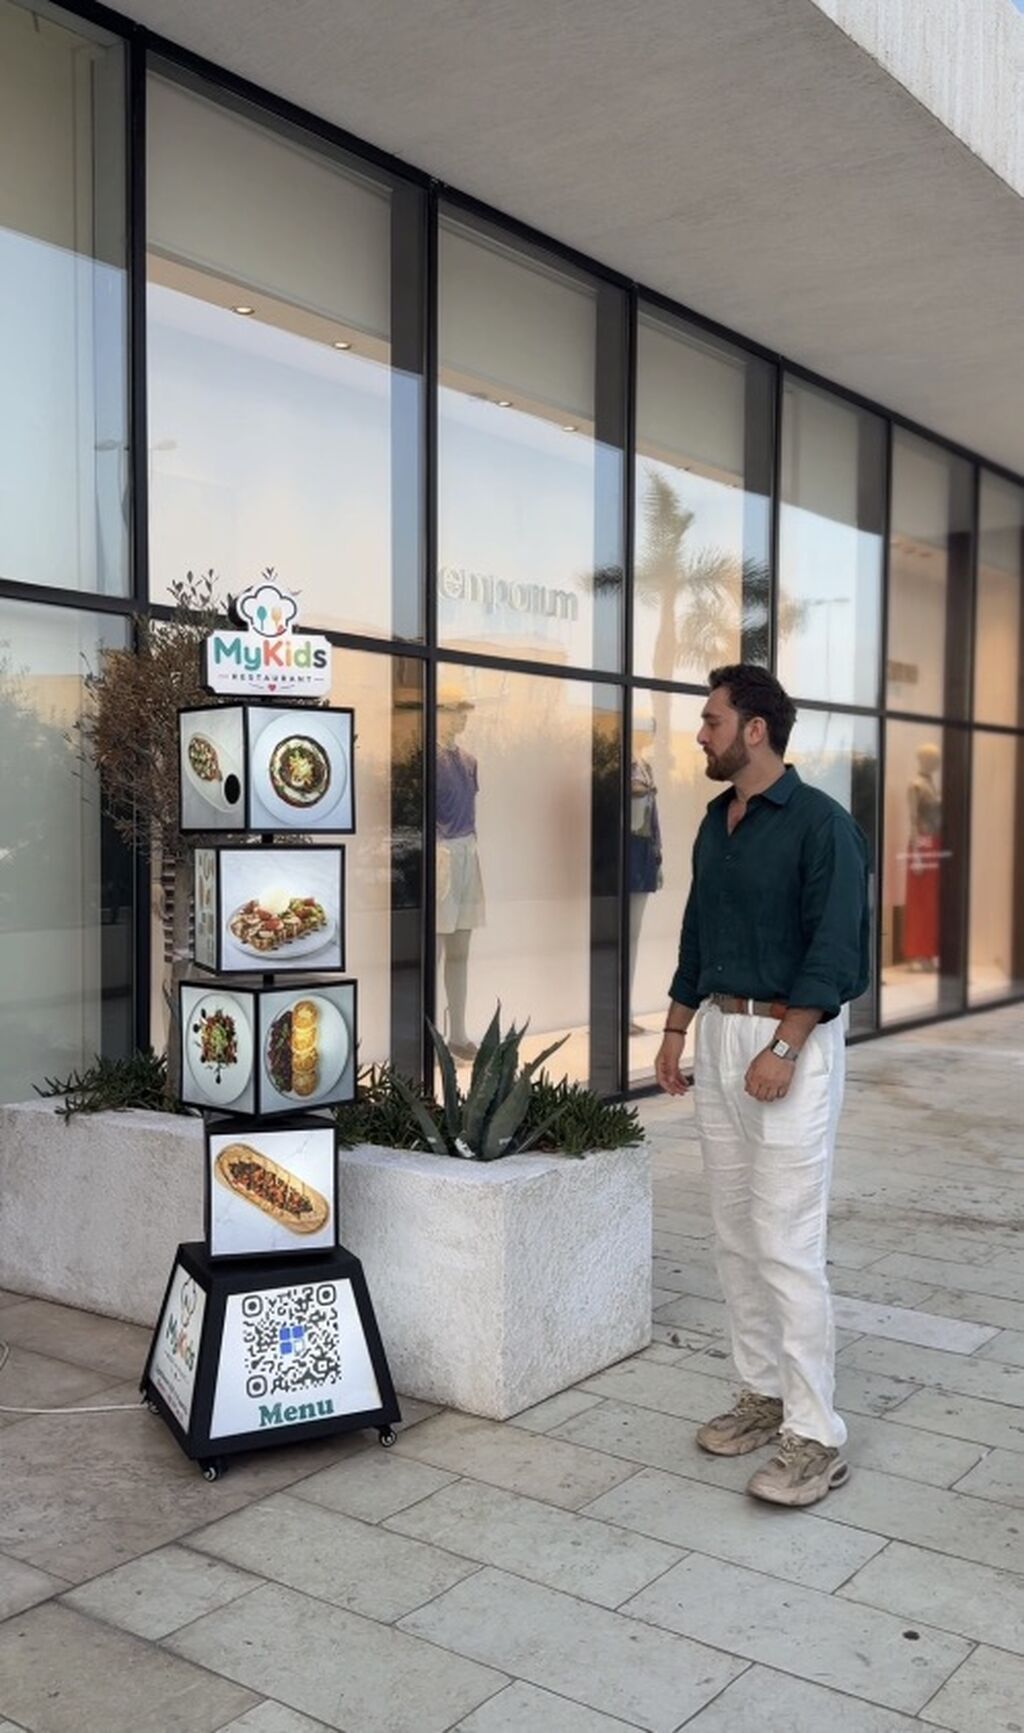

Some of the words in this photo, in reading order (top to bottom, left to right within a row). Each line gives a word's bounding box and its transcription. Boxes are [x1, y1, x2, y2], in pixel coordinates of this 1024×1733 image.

[213, 636, 327, 671] MyKids
[231, 673, 312, 682] RESTAURANT
[258, 1398, 335, 1428] Menu
